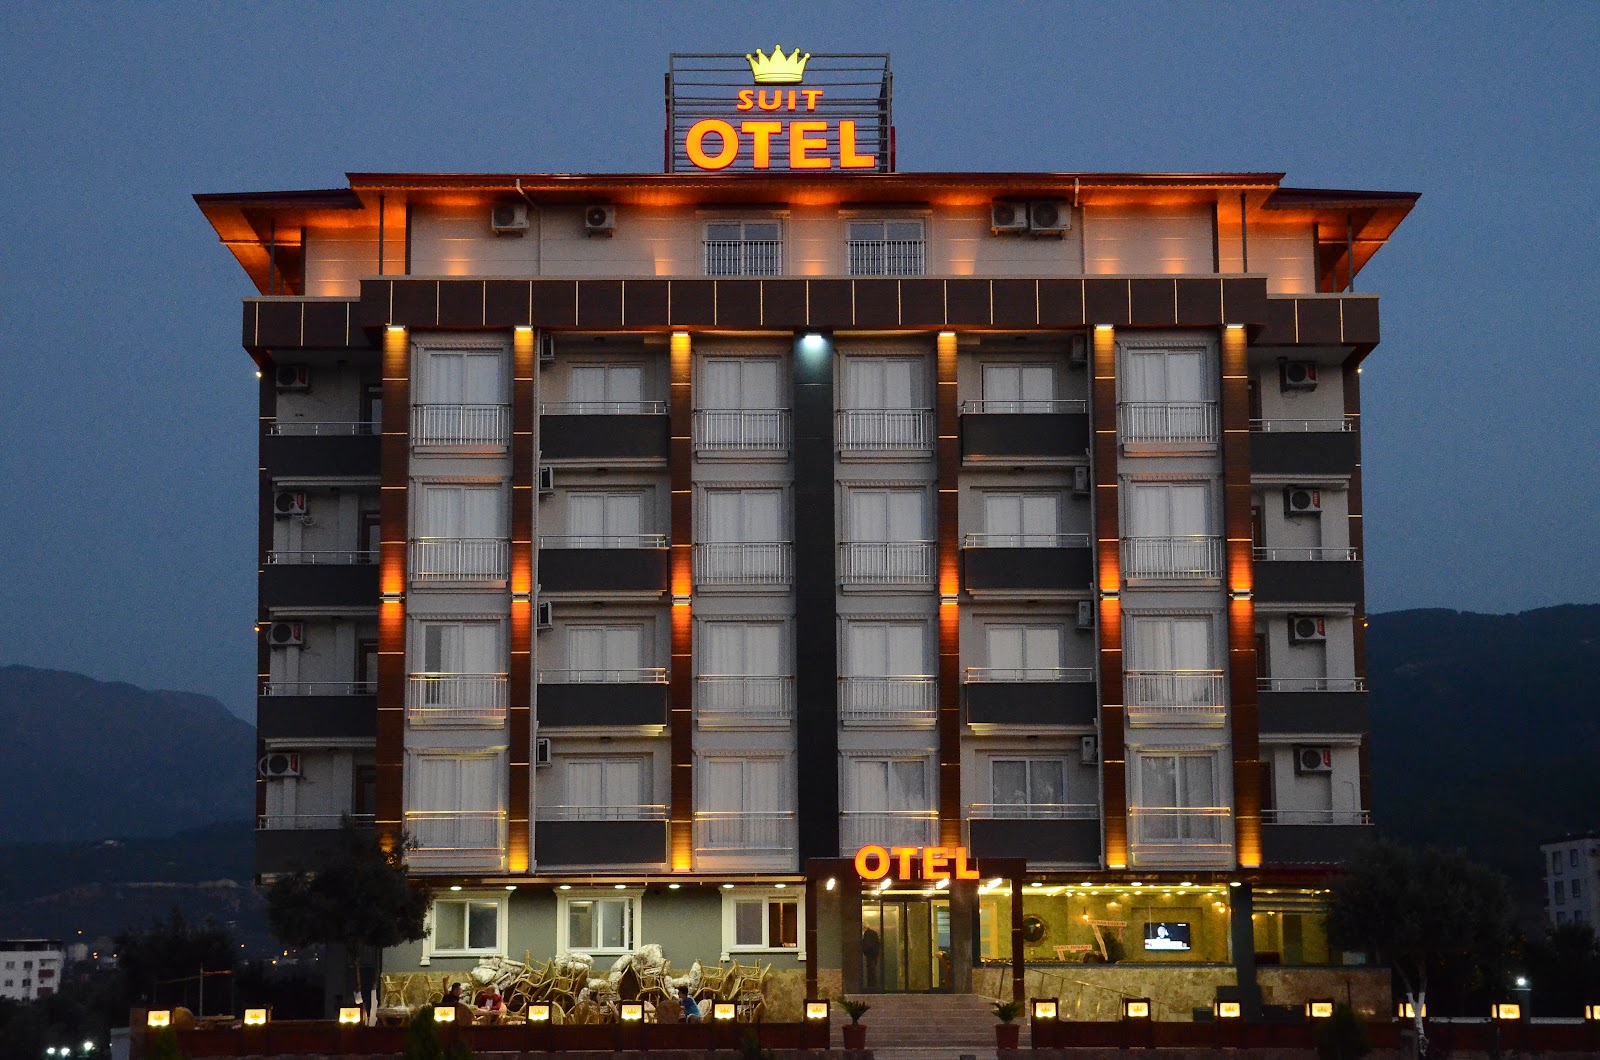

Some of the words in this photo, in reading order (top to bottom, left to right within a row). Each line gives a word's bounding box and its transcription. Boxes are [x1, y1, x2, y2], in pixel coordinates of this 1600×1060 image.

[737, 89, 823, 111] SUIT
[685, 118, 876, 170] OTEL
[854, 844, 980, 880] OTEL
